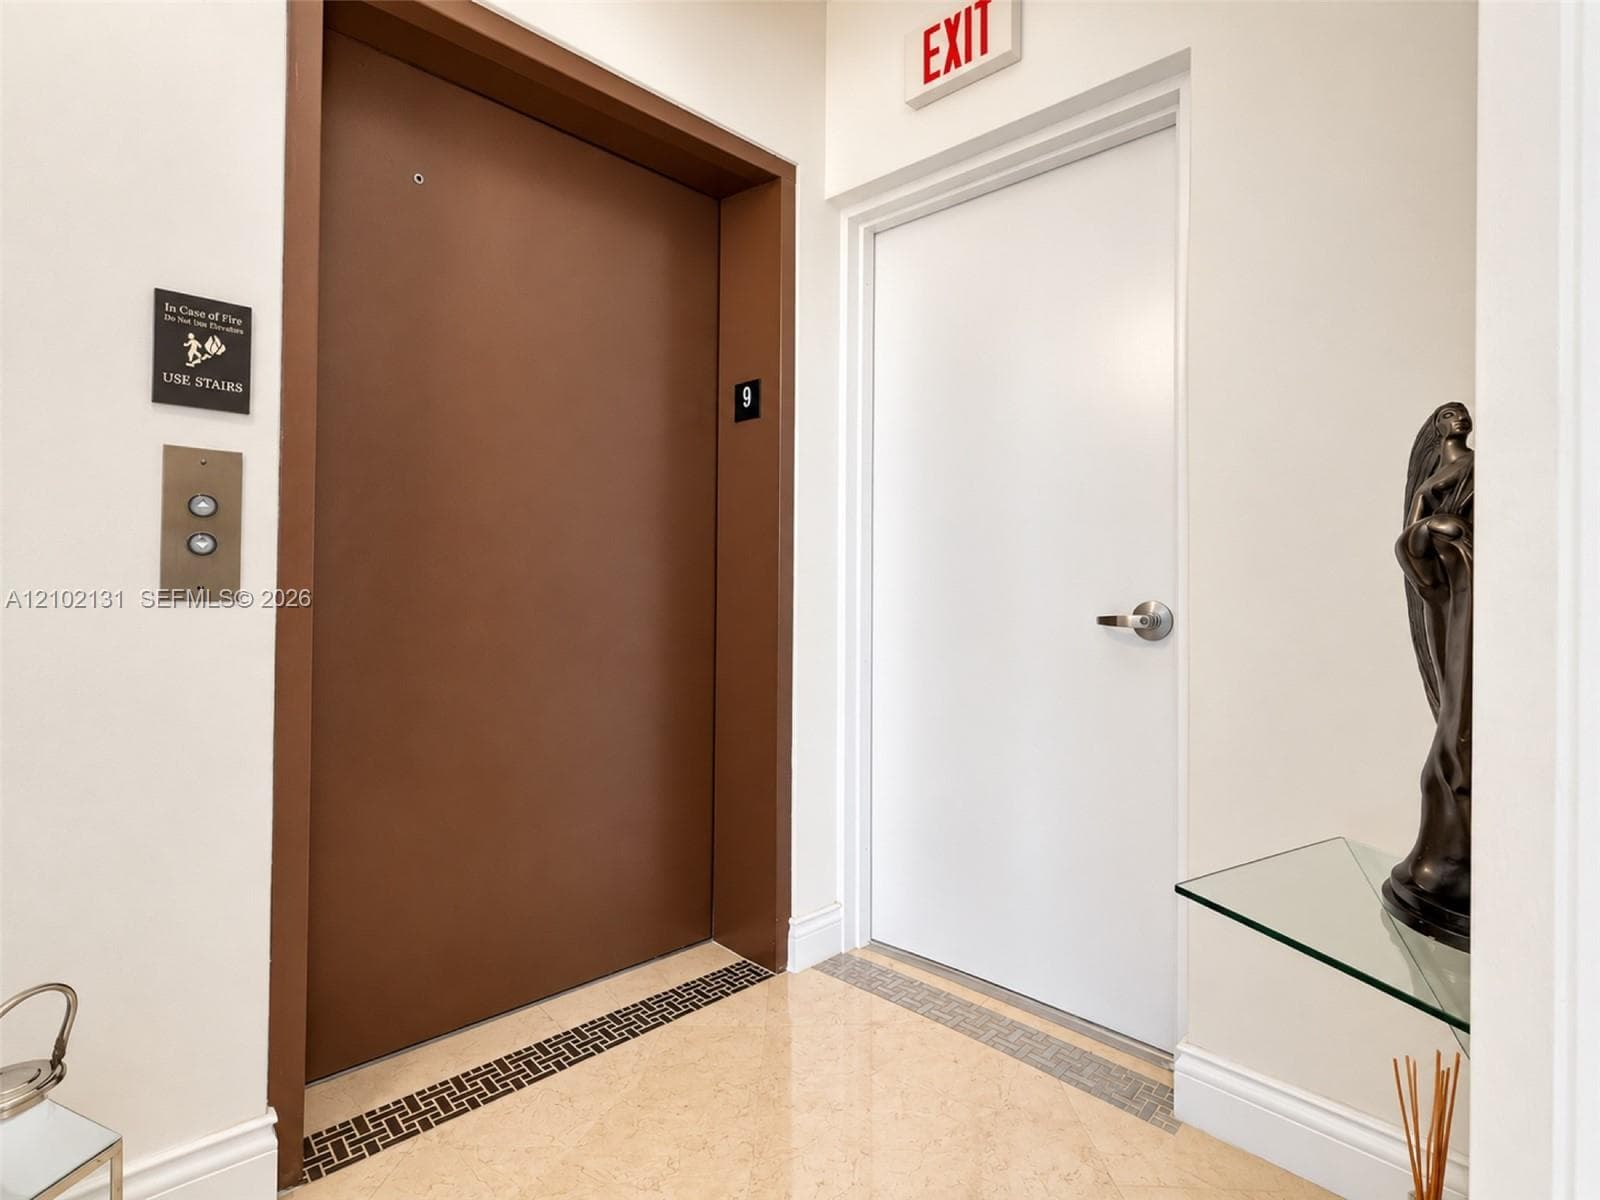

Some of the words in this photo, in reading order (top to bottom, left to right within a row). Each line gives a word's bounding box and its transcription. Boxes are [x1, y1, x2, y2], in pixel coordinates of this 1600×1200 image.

[923, 0, 992, 85] EXIT
[164, 302, 177, 313] In
[179, 306, 206, 319] Case
[208, 312, 220, 321] of
[222, 314, 243, 326] Fire
[164, 313, 175, 322] Do
[177, 316, 191, 325] Not
[162, 372, 191, 386] USE
[195, 376, 243, 393] STAIRS
[742, 386, 752, 408] 9
